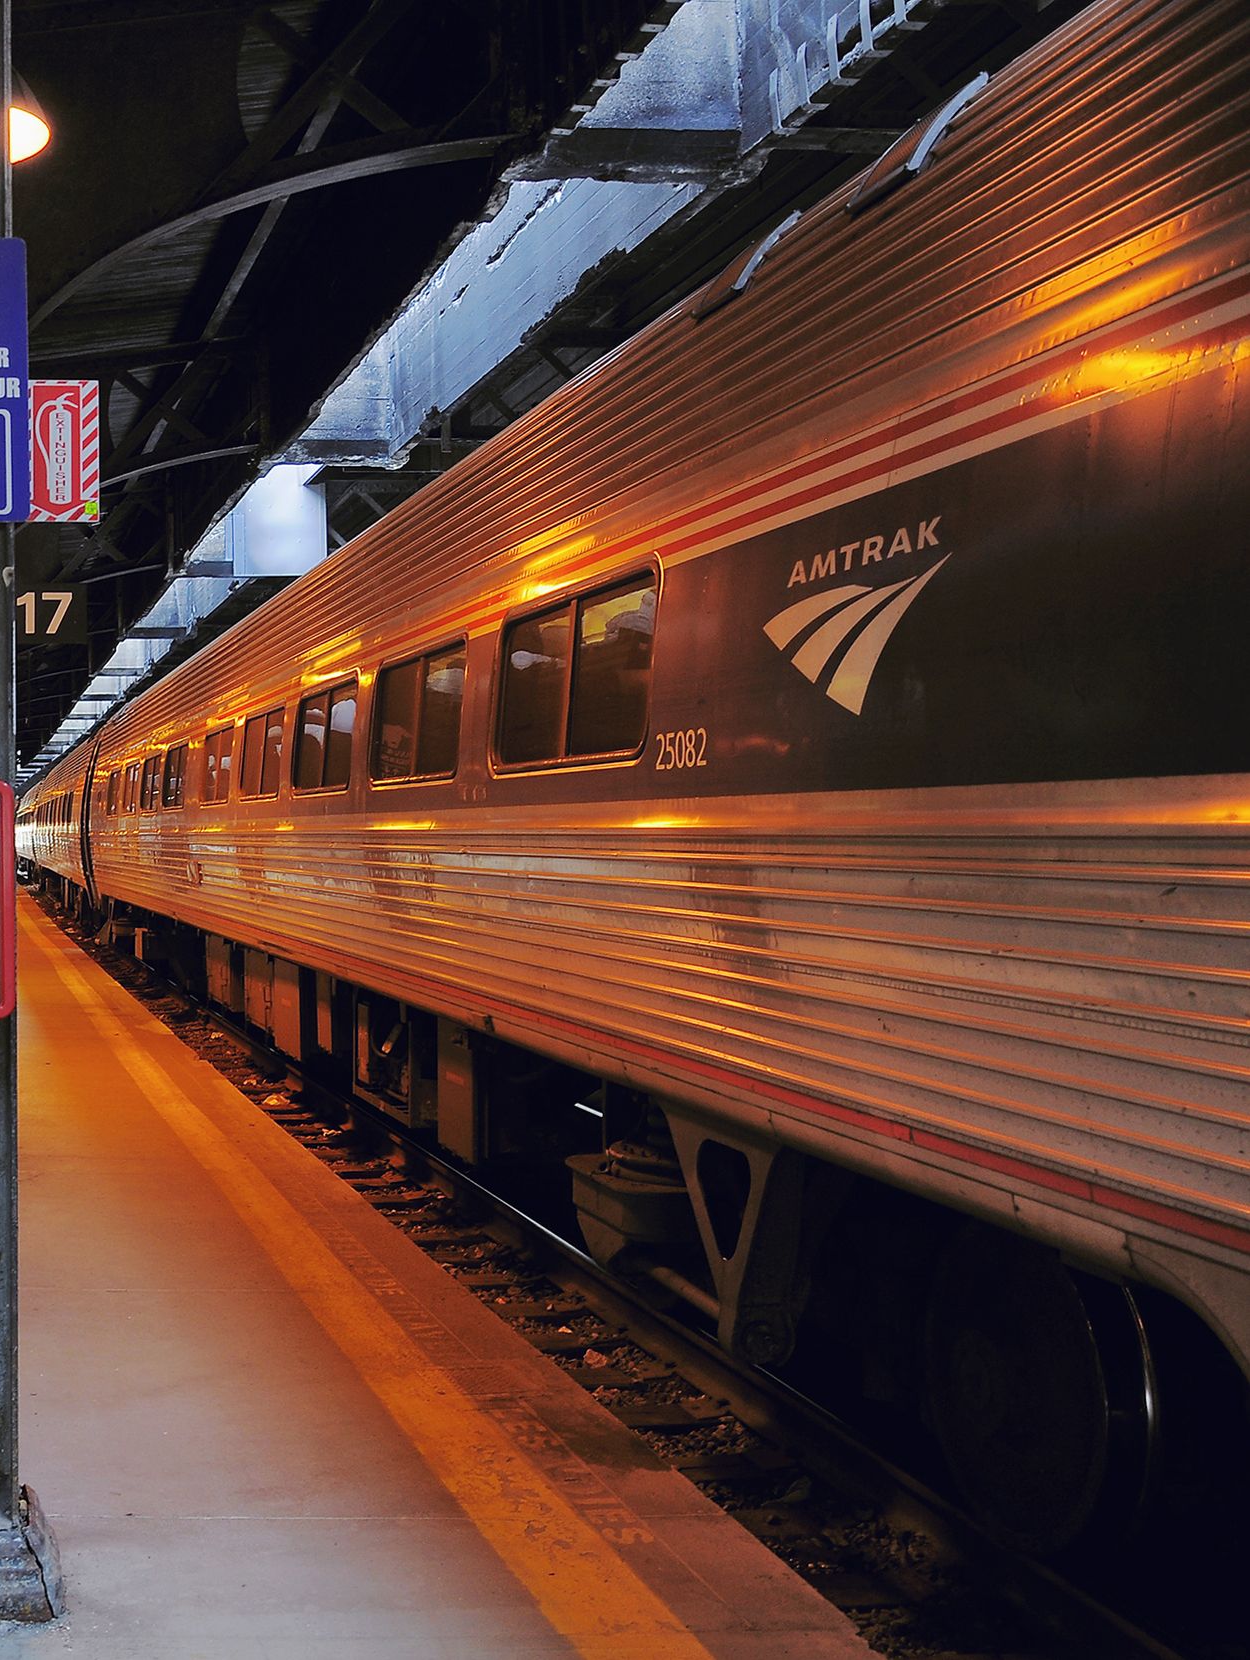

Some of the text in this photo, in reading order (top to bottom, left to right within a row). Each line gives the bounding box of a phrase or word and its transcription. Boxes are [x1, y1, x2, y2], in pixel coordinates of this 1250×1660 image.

[55, 412, 66, 501] EXTINGUISHER
[786, 515, 942, 588] AMTRAK
[16, 591, 73, 635] 17
[655, 727, 707, 770] 25082
